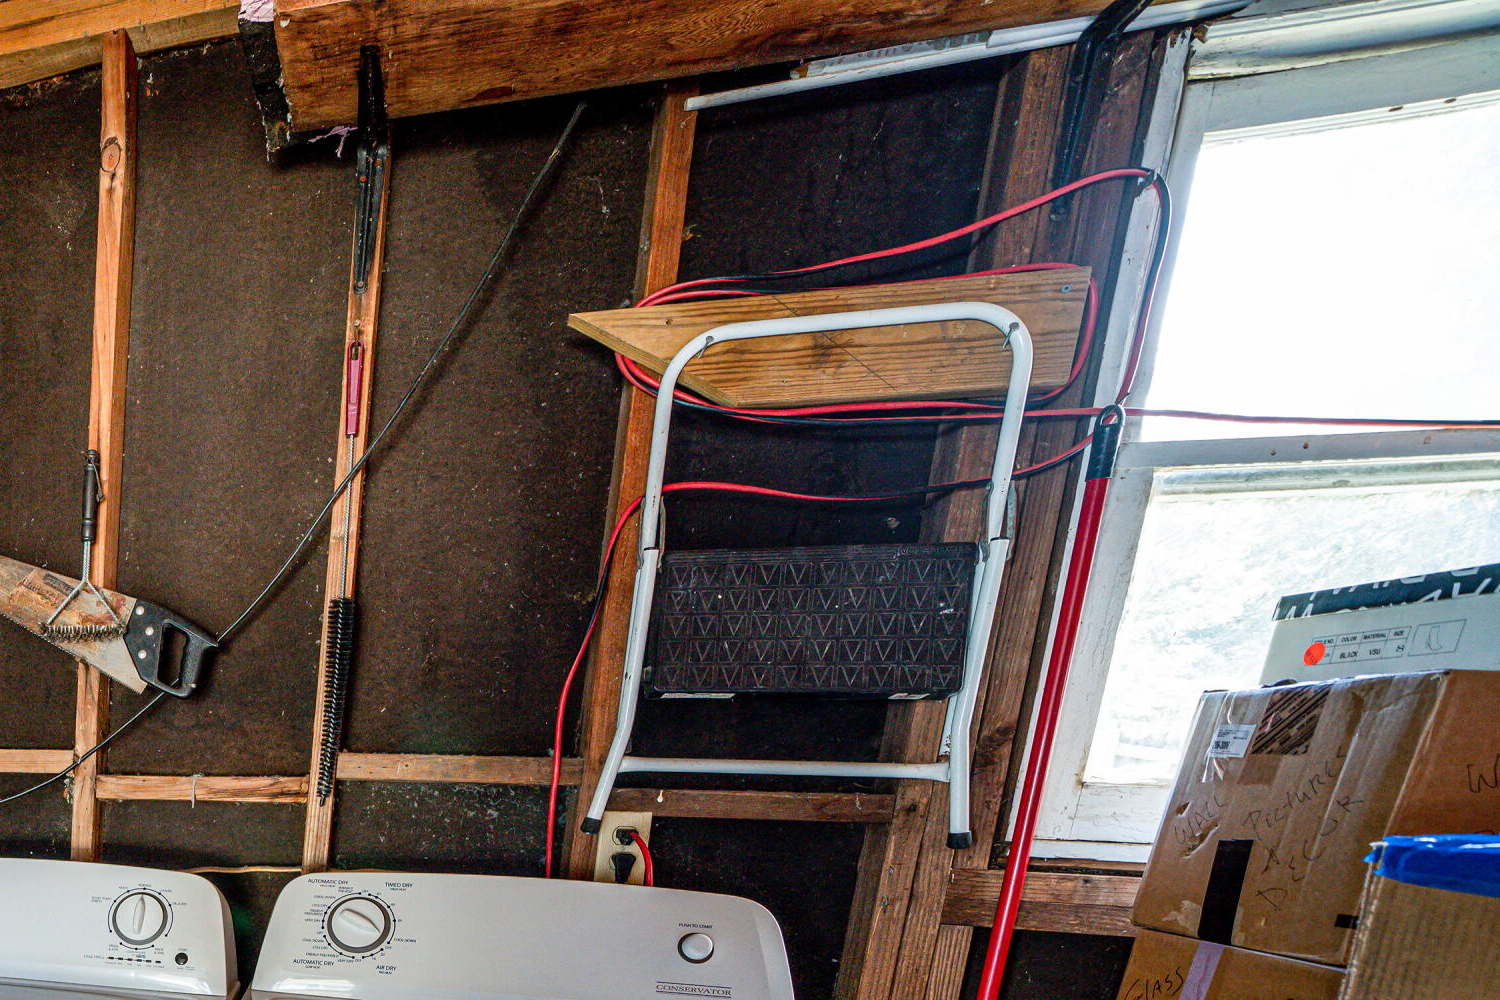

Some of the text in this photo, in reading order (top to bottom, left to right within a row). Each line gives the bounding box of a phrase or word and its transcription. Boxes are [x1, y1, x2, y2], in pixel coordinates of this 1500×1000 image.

[1340, 651, 1358, 659] BLACK
[1174, 794, 1229, 845] WALL
[292, 958, 323, 966] AUTOMATIC
[655, 984, 732, 996] CONSERVATOR
